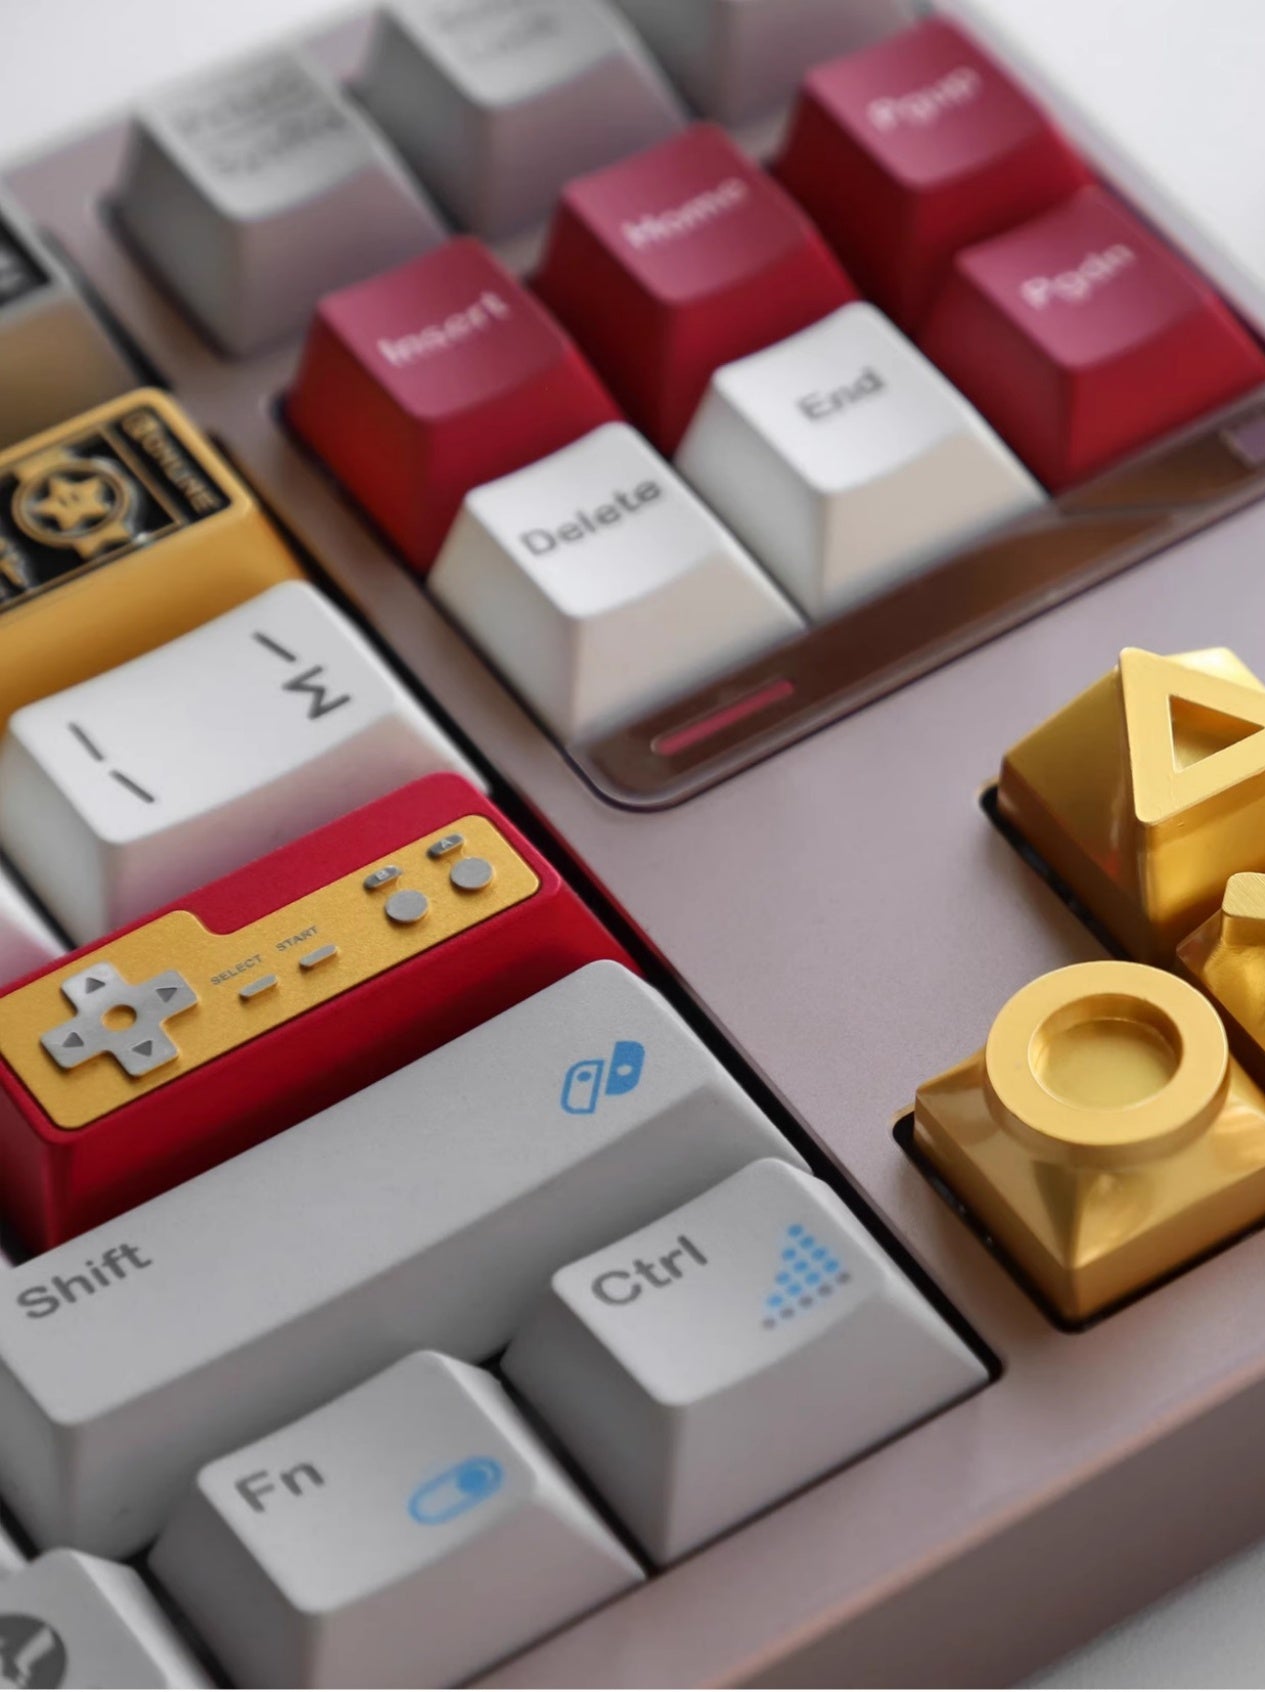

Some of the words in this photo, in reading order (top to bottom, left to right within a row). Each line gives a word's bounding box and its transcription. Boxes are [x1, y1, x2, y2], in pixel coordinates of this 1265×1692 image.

[621, 178, 748, 250] Home
[376, 291, 509, 367] Insert
[797, 366, 887, 422] End
[519, 478, 665, 557] Delete
[440, 838, 454, 849] A
[375, 869, 390, 881] B
[275, 925, 320, 953] START
[210, 953, 263, 986] SELECT
[15, 1242, 154, 1320] Shift
[591, 1235, 709, 1307] Ctrl
[235, 1462, 326, 1513] Fn
